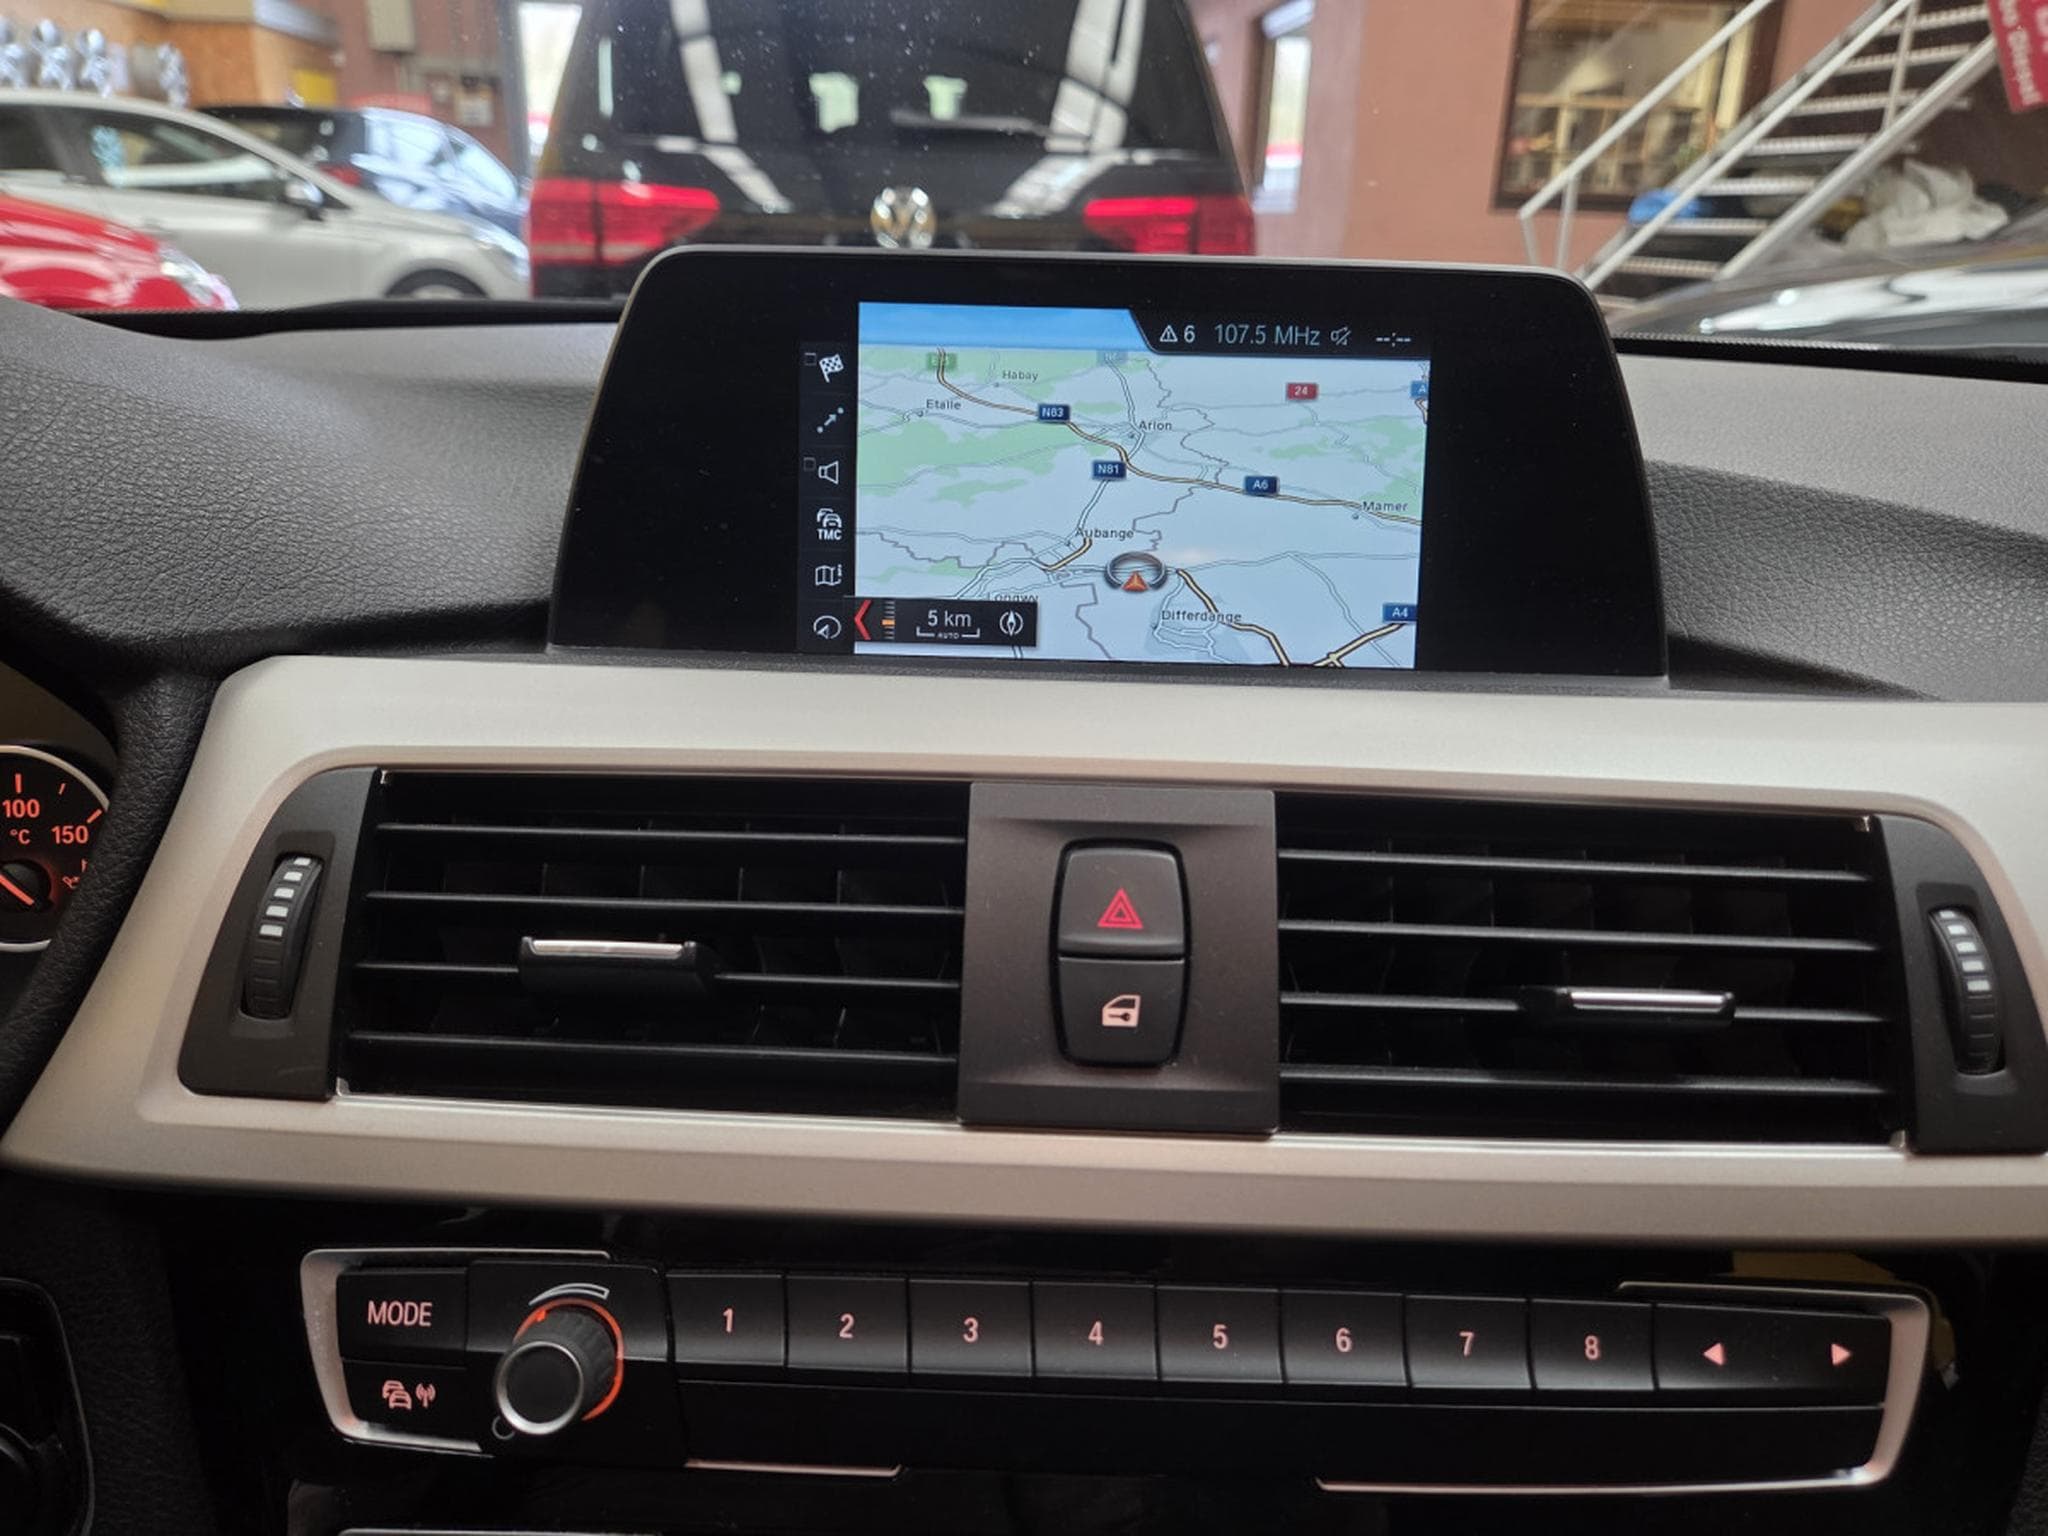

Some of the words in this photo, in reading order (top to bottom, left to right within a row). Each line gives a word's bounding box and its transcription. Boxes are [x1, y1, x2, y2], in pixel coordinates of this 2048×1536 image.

[1184, 325, 1195, 343] 6
[1215, 324, 1266, 345] 107.5
[1275, 326, 1320, 346] MHz
[1002, 369, 1038, 383] Habay
[1294, 385, 1309, 397] 24
[1098, 463, 1119, 475] N81
[1252, 479, 1269, 490] A6
[1363, 501, 1408, 512] Mamer
[817, 528, 842, 541] TMC
[1074, 528, 1134, 542] Aubange
[928, 609, 938, 627] 5
[944, 610, 971, 627] km
[1161, 609, 1242, 623] Differdange
[1391, 607, 1409, 618] A4
[2, 799, 40, 818] 100
[10, 829, 31, 845] °C
[51, 825, 89, 844] 150
[367, 1301, 432, 1327] MODE
[722, 1308, 735, 1333] 1
[839, 1313, 854, 1339] 2
[963, 1317, 979, 1343] 3
[1088, 1321, 1104, 1346] 4
[1212, 1324, 1228, 1350] 5
[1335, 1328, 1352, 1353] 6
[1459, 1331, 1475, 1356] 7
[1584, 1335, 1600, 1360] 8
